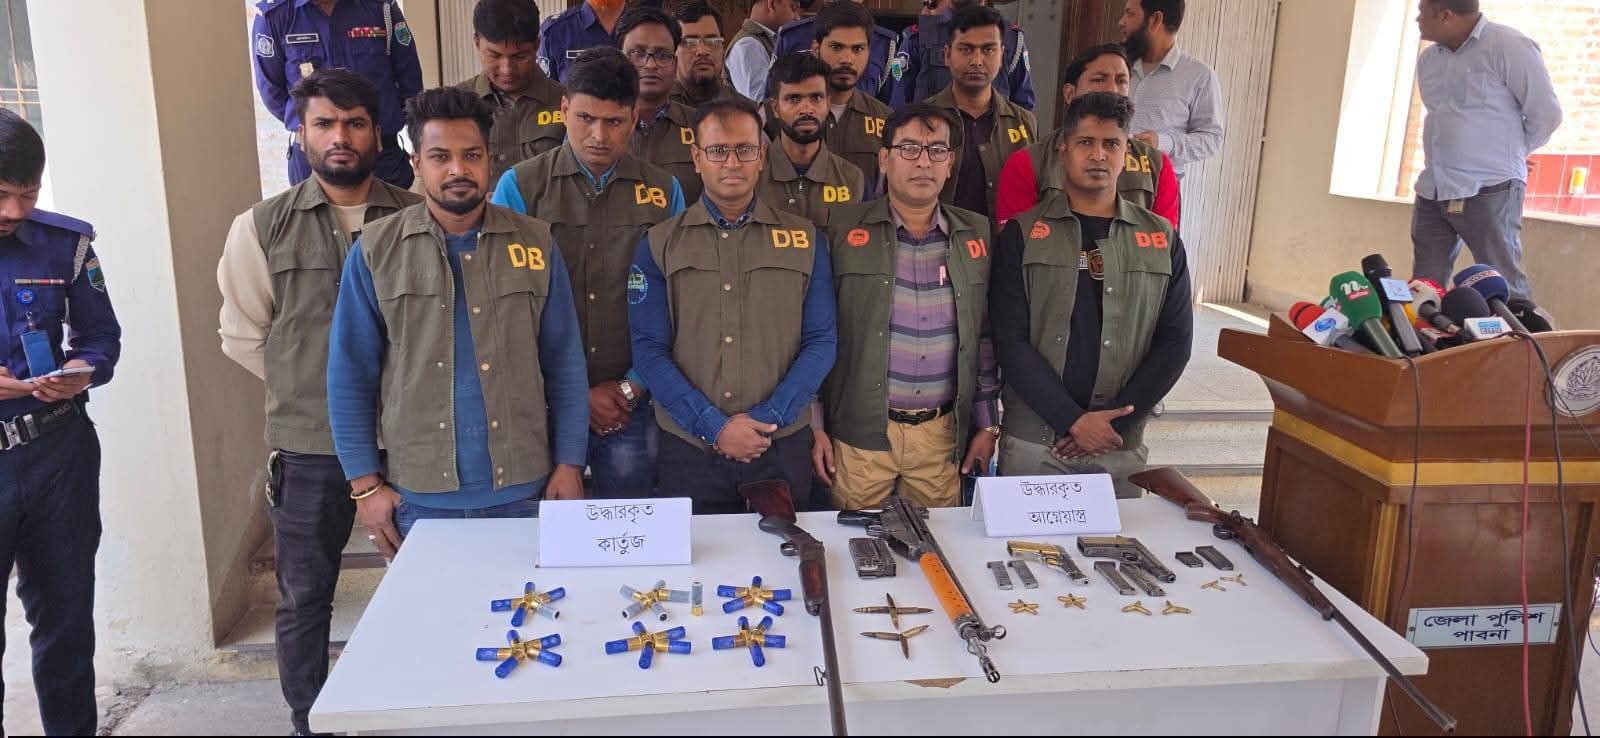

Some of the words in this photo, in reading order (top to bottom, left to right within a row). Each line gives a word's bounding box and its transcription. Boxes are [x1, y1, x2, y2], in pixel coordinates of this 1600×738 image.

[680, 127, 696, 145] D
[634, 183, 668, 208] DB
[823, 185, 850, 203] DB
[771, 229, 809, 249] DB
[1134, 231, 1168, 249] DB
[507, 243, 545, 271] DB
[1020, 481, 1082, 499] উদ্ধারকৃত
[585, 503, 655, 524] উদ্ধারকৃত
[1028, 509, 1086, 525] আগ্নেয়াস্ত্র
[597, 532, 646, 555] কার্তুজ
[1423, 613, 1478, 628] জেলা
[1487, 609, 1546, 628] পুলিশ
[1453, 628, 1512, 642] পাবনা
